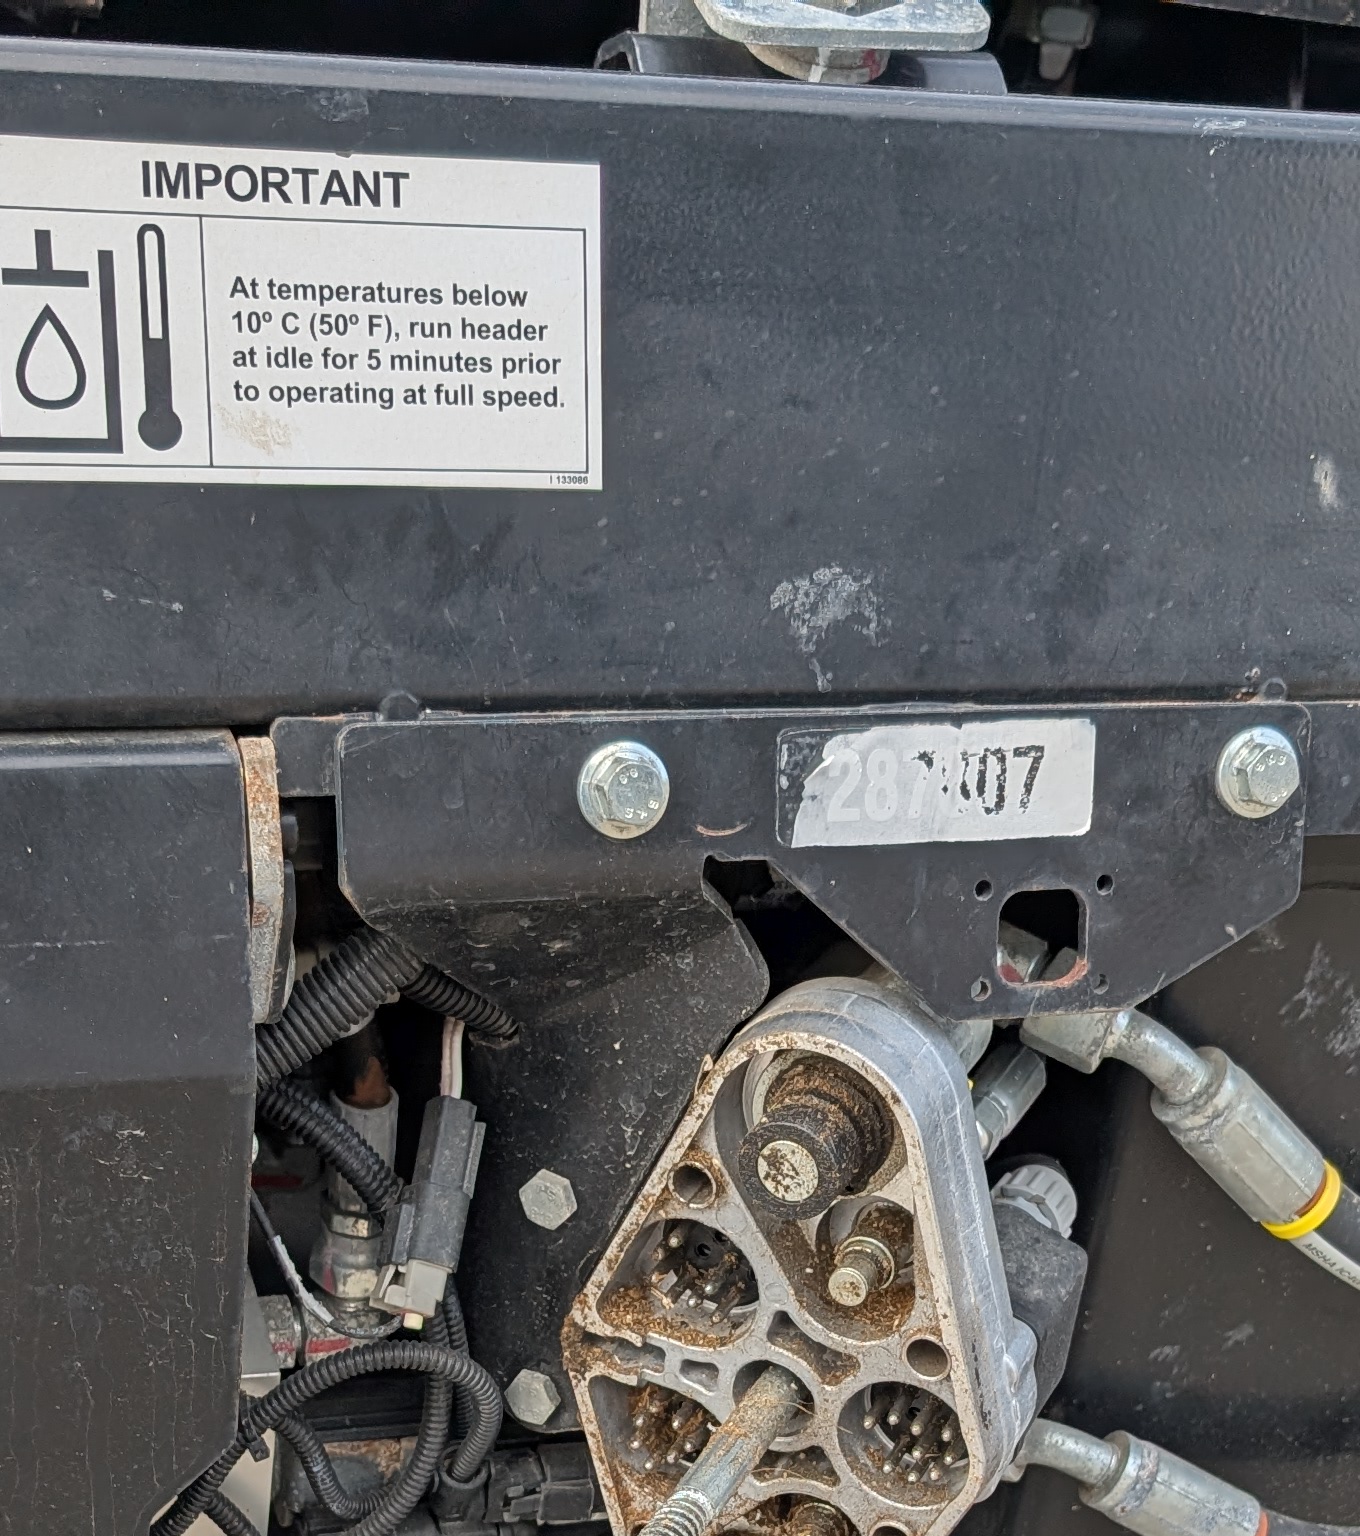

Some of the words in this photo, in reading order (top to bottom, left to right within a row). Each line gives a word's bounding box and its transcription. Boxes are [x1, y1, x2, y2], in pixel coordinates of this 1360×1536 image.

[141, 160, 410, 209] IMPORTANT
[229, 276, 262, 301] At
[266, 279, 444, 307] temperatures
[451, 283, 528, 308] below
[281, 313, 300, 337] C
[367, 315, 401, 342] F),
[409, 319, 453, 341] run
[460, 317, 548, 343] header
[232, 348, 258, 369] at
[266, 346, 313, 370] idle
[321, 347, 359, 371] for
[366, 348, 383, 371] 5
[389, 348, 494, 374] minutes
[501, 353, 561, 379] prior
[233, 381, 261, 403] to
[268, 382, 394, 409] operating
[402, 385, 427, 405] at
[434, 383, 475, 407] full
[481, 385, 566, 411] speed.
